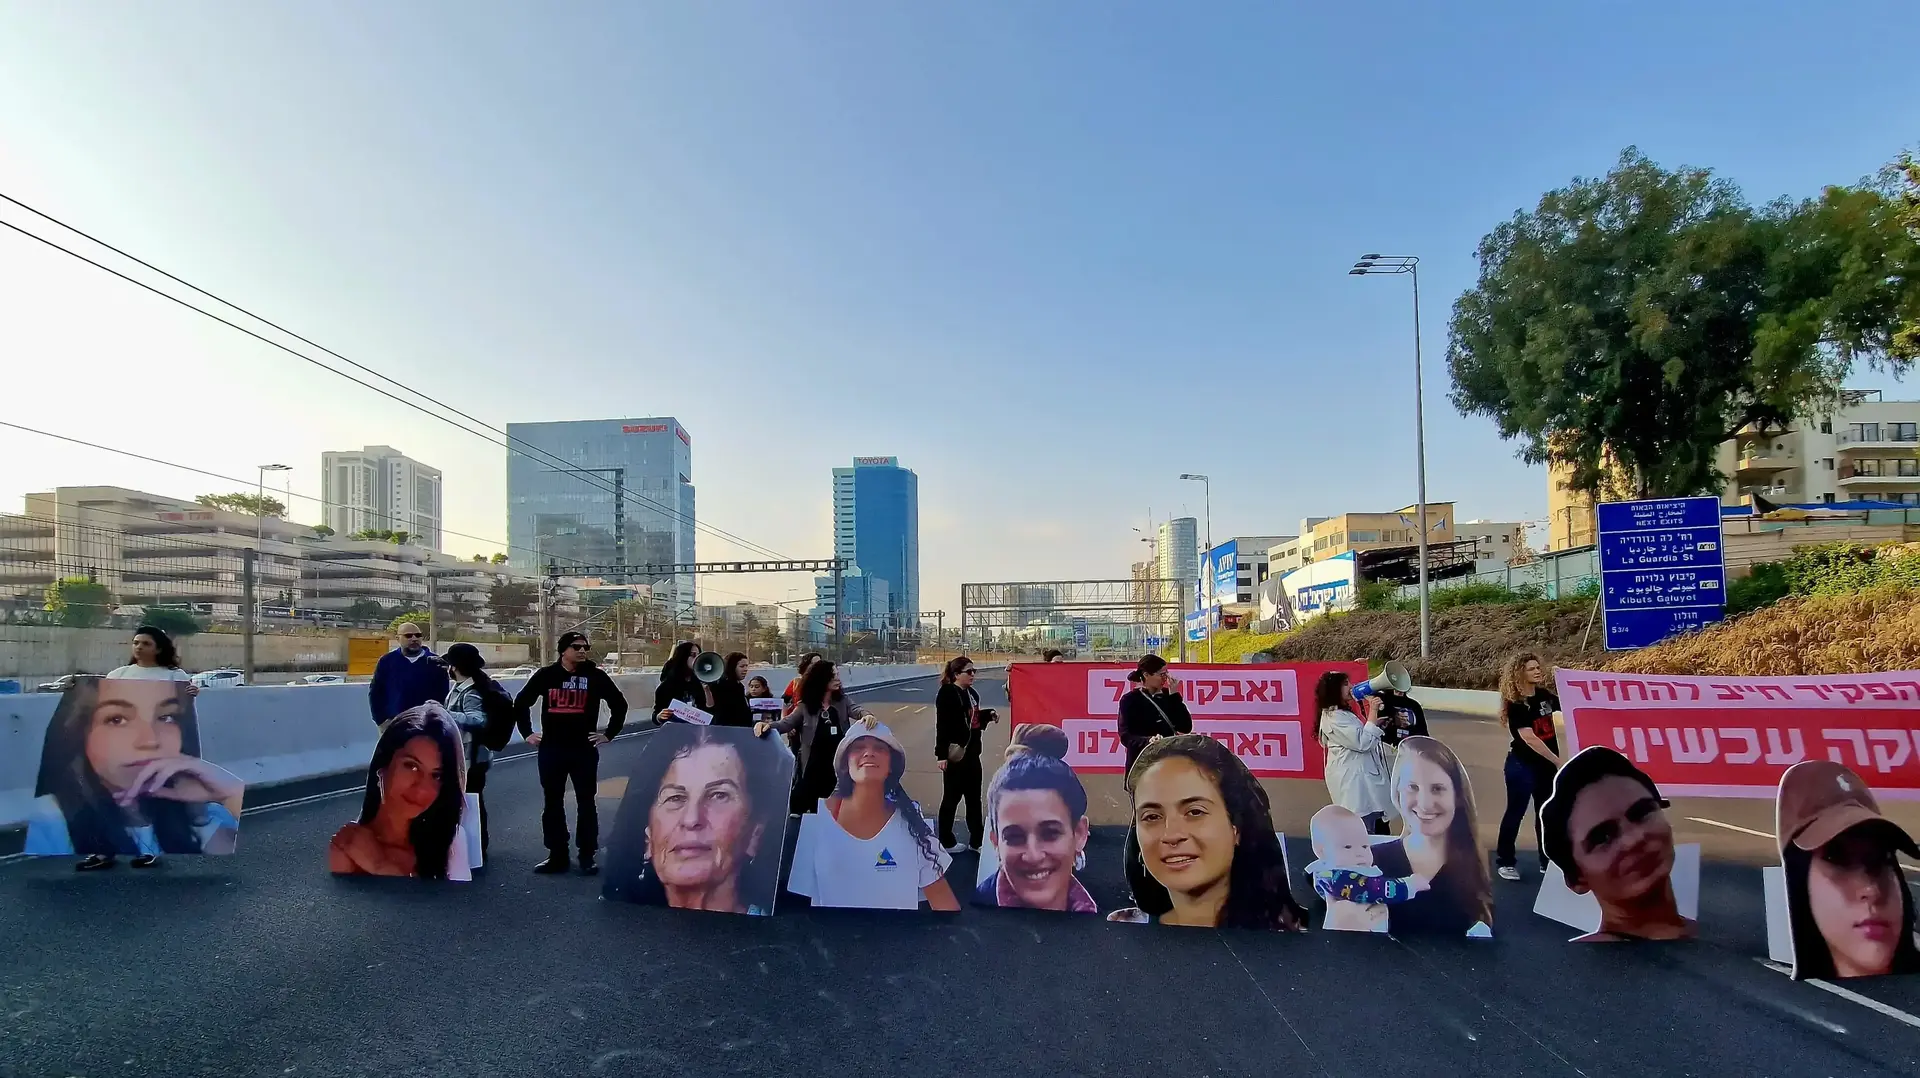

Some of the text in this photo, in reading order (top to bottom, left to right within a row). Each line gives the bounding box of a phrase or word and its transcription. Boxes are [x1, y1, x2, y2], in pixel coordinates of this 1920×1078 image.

[857, 457, 889, 465] TOYOTA
[1656, 502, 1686, 510] היציאות
[1660, 533, 1673, 542] לה
[1218, 552, 1235, 573] AVIV
[1639, 554, 1678, 563] Guardia
[1682, 553, 1694, 561] St
[1635, 572, 1696, 582] קיבוץ גלויות
[1619, 594, 1697, 604] Kibuts Galuyot
[1673, 612, 1698, 621] חולון
[1567, 680, 1700, 701] להחזיר
[1710, 684, 1793, 701] חייב
[1078, 729, 1121, 754] לנו
[1821, 728, 1920, 773] קה
